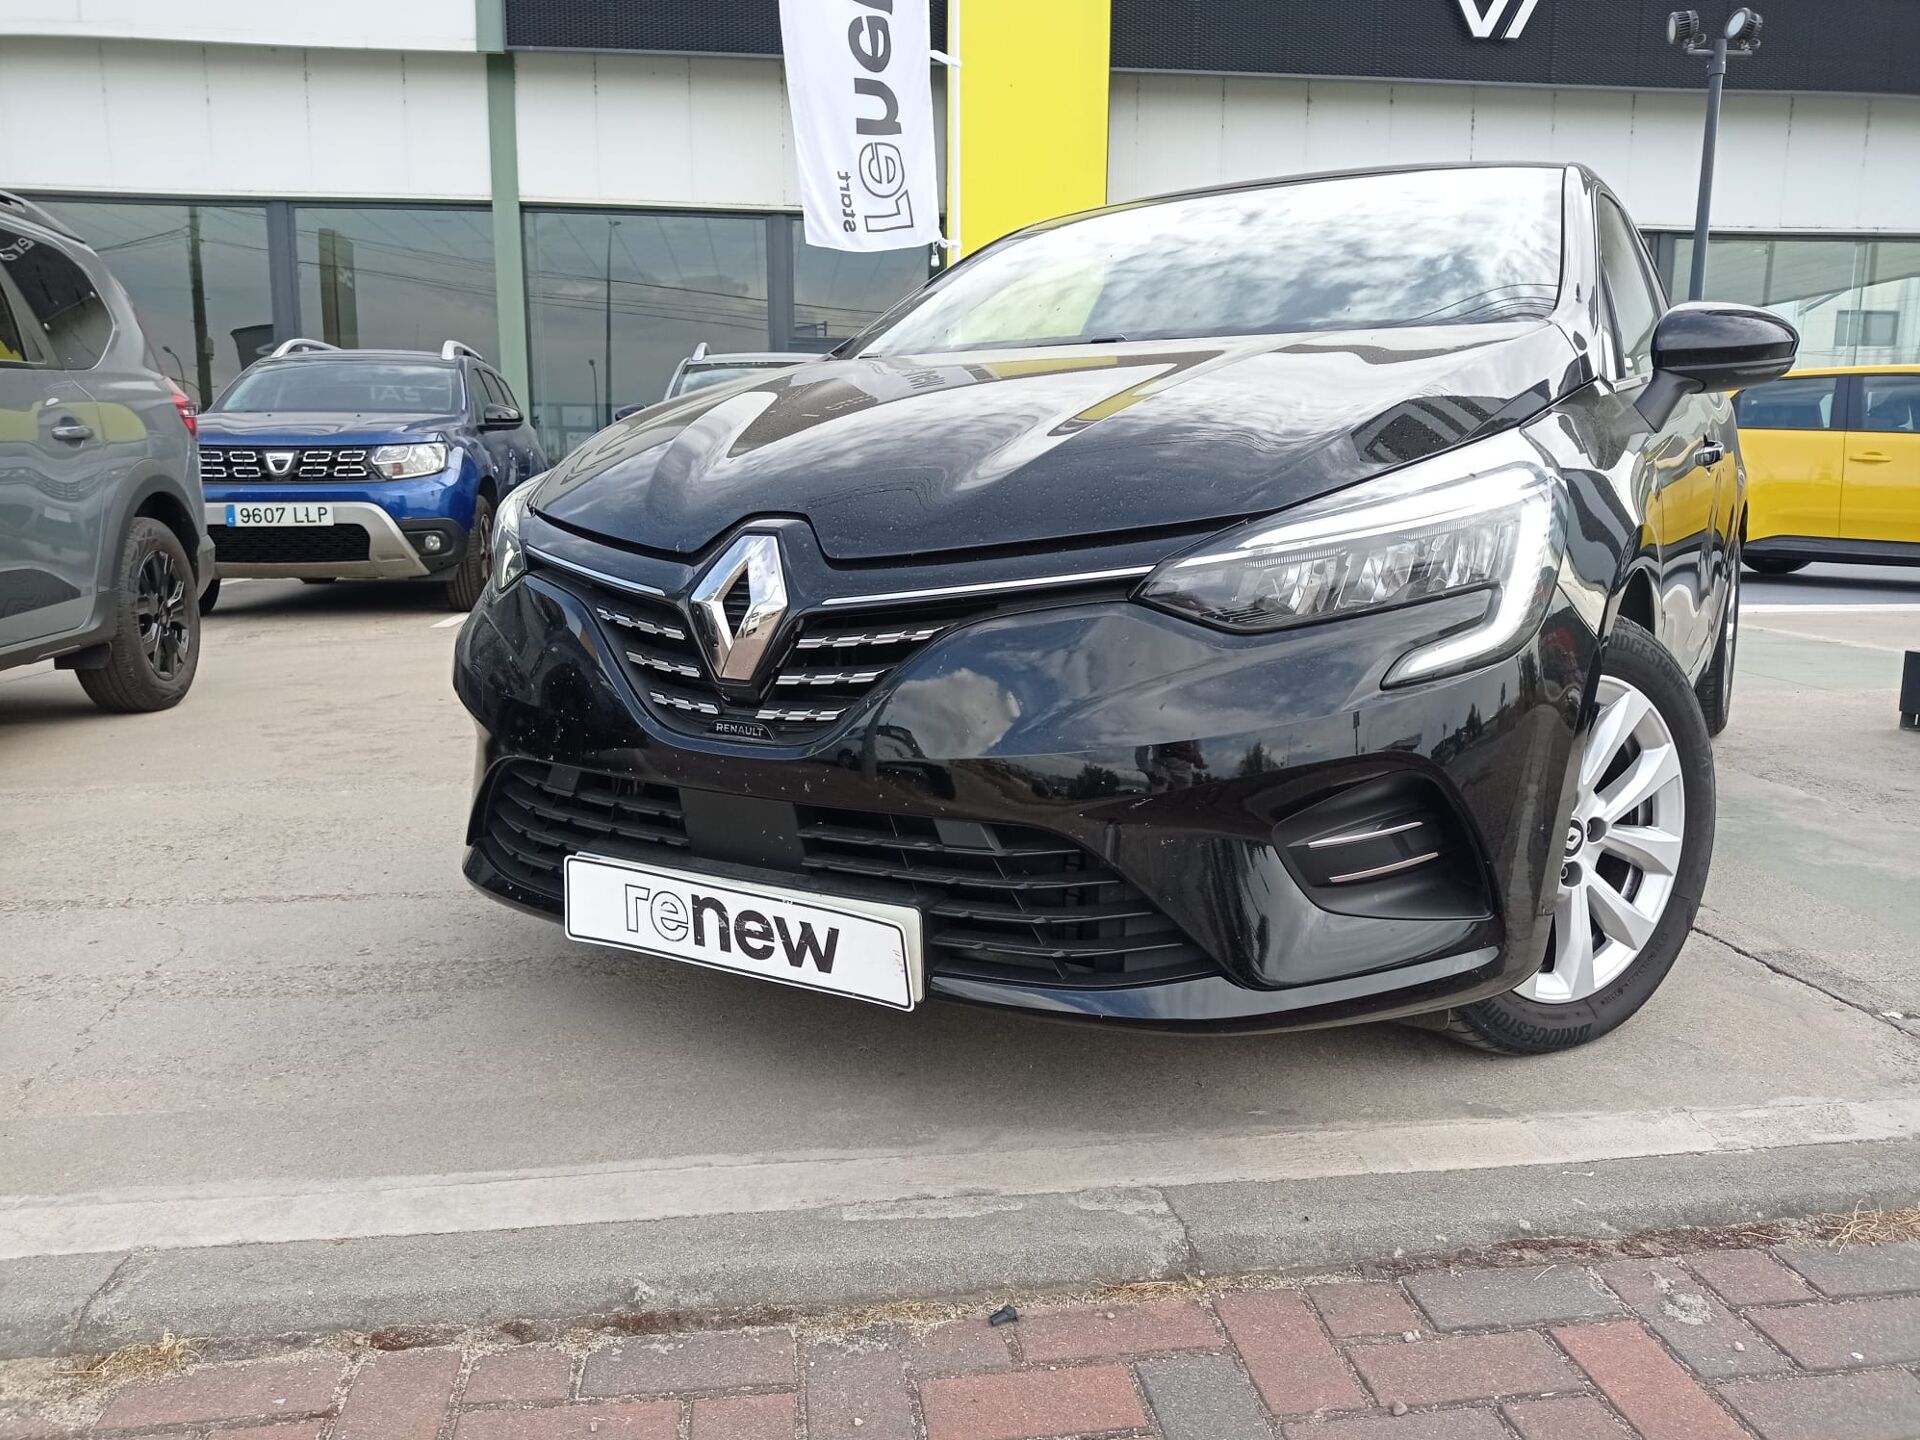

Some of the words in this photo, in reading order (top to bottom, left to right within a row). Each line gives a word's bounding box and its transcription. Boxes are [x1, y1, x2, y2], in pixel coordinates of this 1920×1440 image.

[240, 507, 286, 524] 9607
[293, 506, 328, 524] LLP
[715, 723, 765, 737] RENAULT
[624, 883, 840, 974] renew
